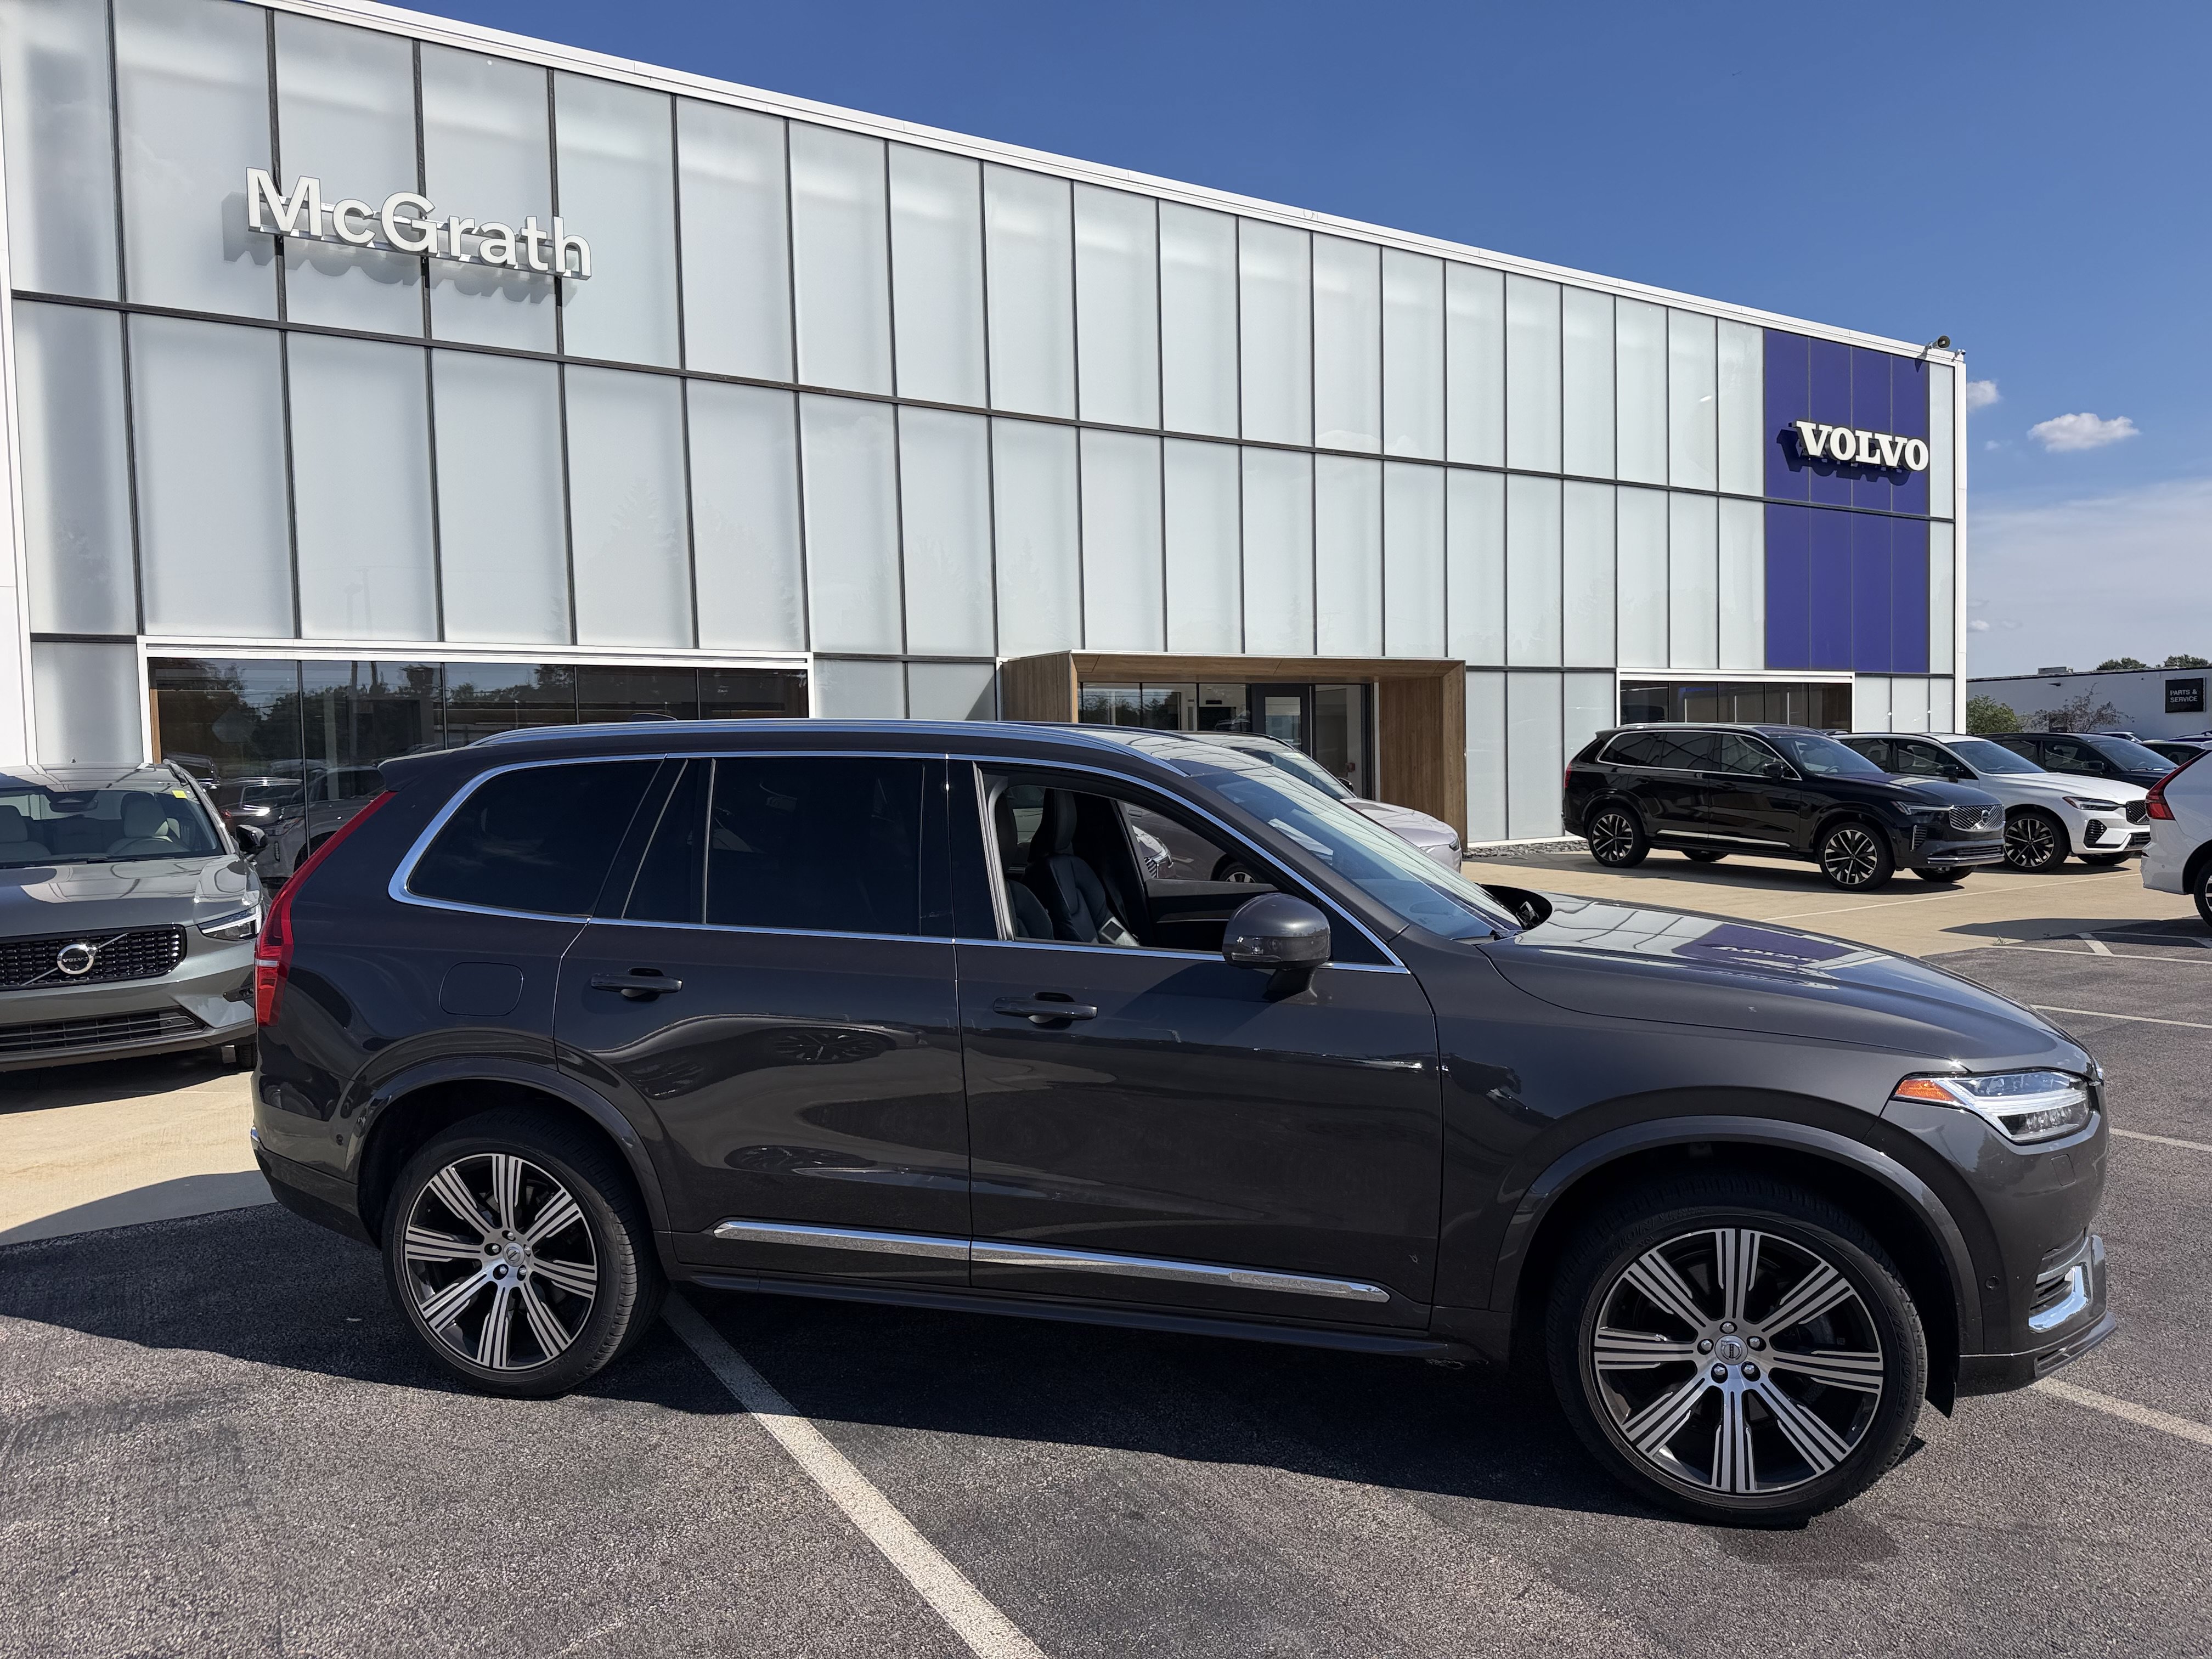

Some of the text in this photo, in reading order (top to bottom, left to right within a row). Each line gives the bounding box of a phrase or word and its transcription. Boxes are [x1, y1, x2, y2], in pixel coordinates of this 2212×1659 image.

[245, 166, 592, 281] McGrath
[1795, 420, 1929, 472] VOLVO
[1251, 1276, 1330, 1290] RECHARGE
